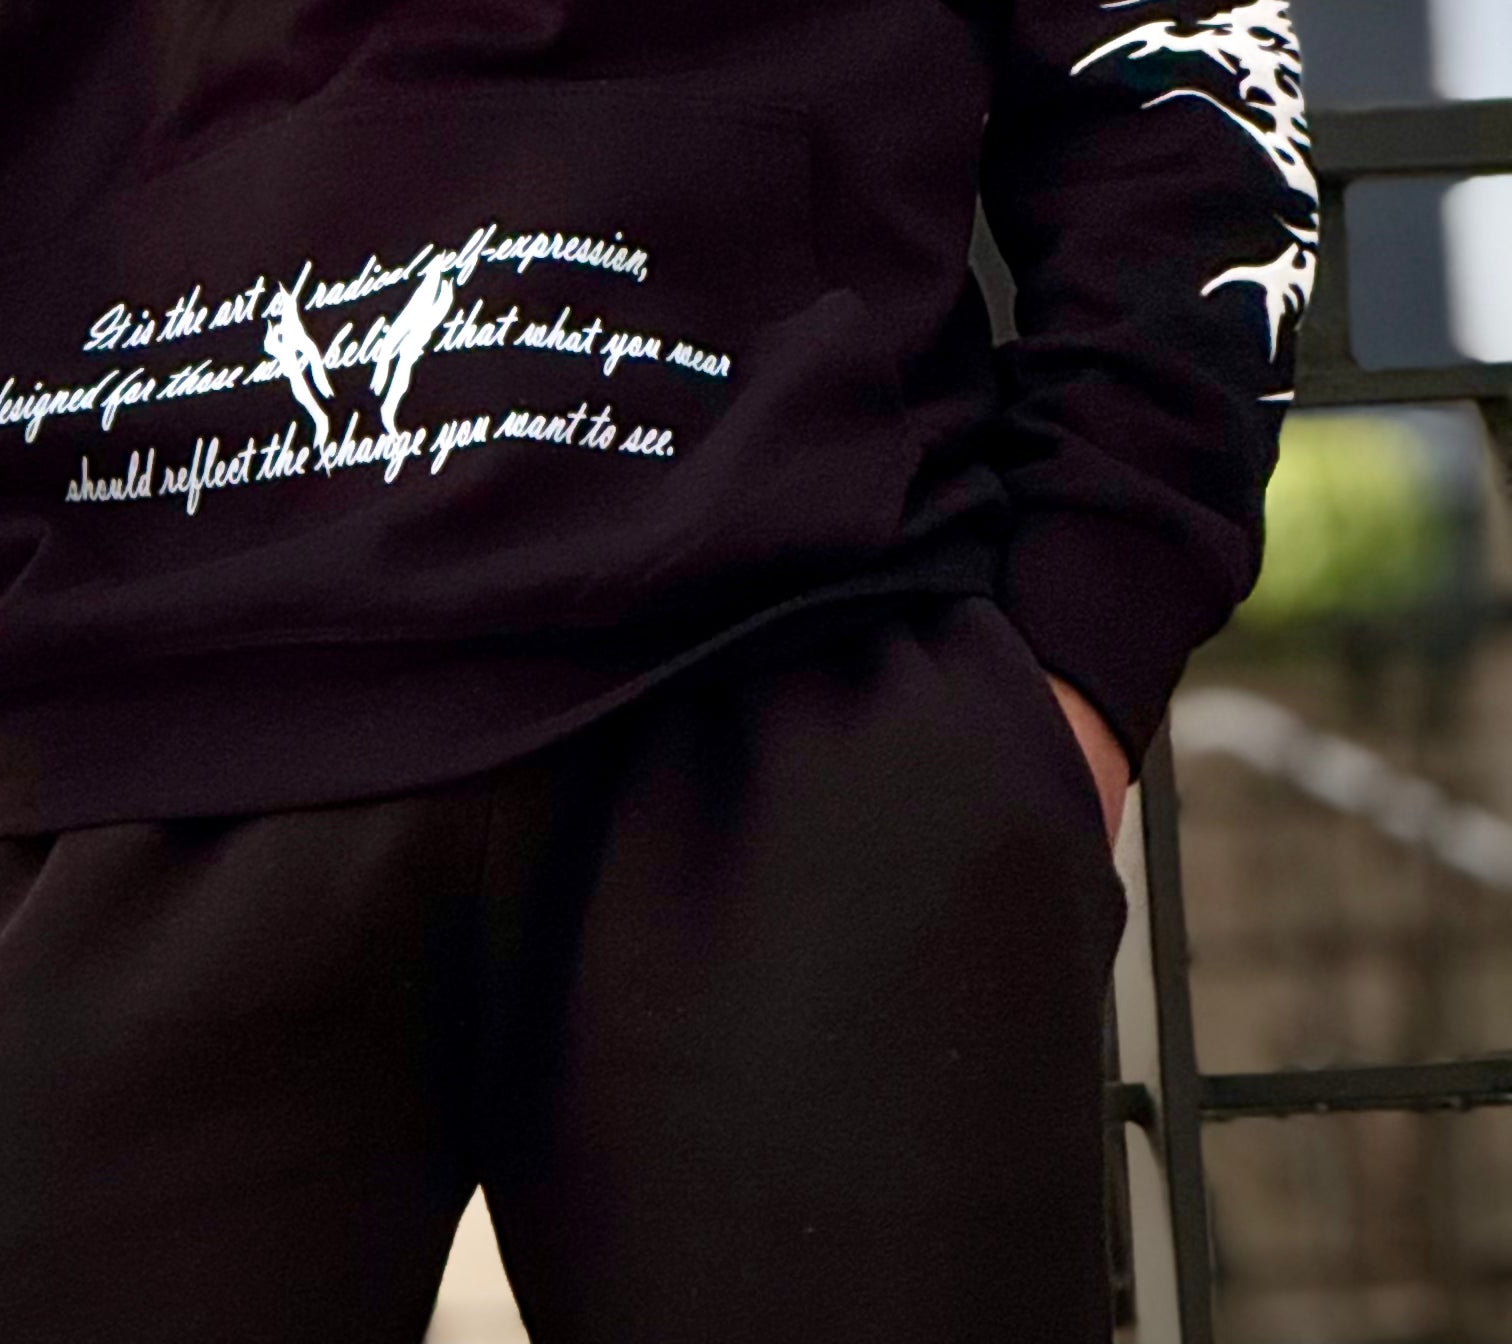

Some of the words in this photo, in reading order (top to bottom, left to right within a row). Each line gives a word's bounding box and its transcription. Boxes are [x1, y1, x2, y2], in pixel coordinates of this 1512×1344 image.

[83, 304, 132, 350] It
[122, 311, 155, 348] is
[156, 285, 208, 342] the
[209, 276, 265, 330] art
[304, 243, 434, 310] radical
[417, 224, 648, 285] self-expression,
[100, 367, 156, 432] for
[156, 360, 244, 400] those
[434, 299, 518, 352] that
[514, 306, 603, 354] what
[600, 333, 661, 377] you
[666, 338, 731, 377] wear
[65, 447, 155, 503] should
[159, 437, 256, 516] reflect
[256, 421, 310, 481] the
[314, 411, 427, 484] change
[429, 415, 490, 475] you
[493, 402, 588, 445] want
[579, 405, 617, 450] to
[618, 425, 675, 457] see.
